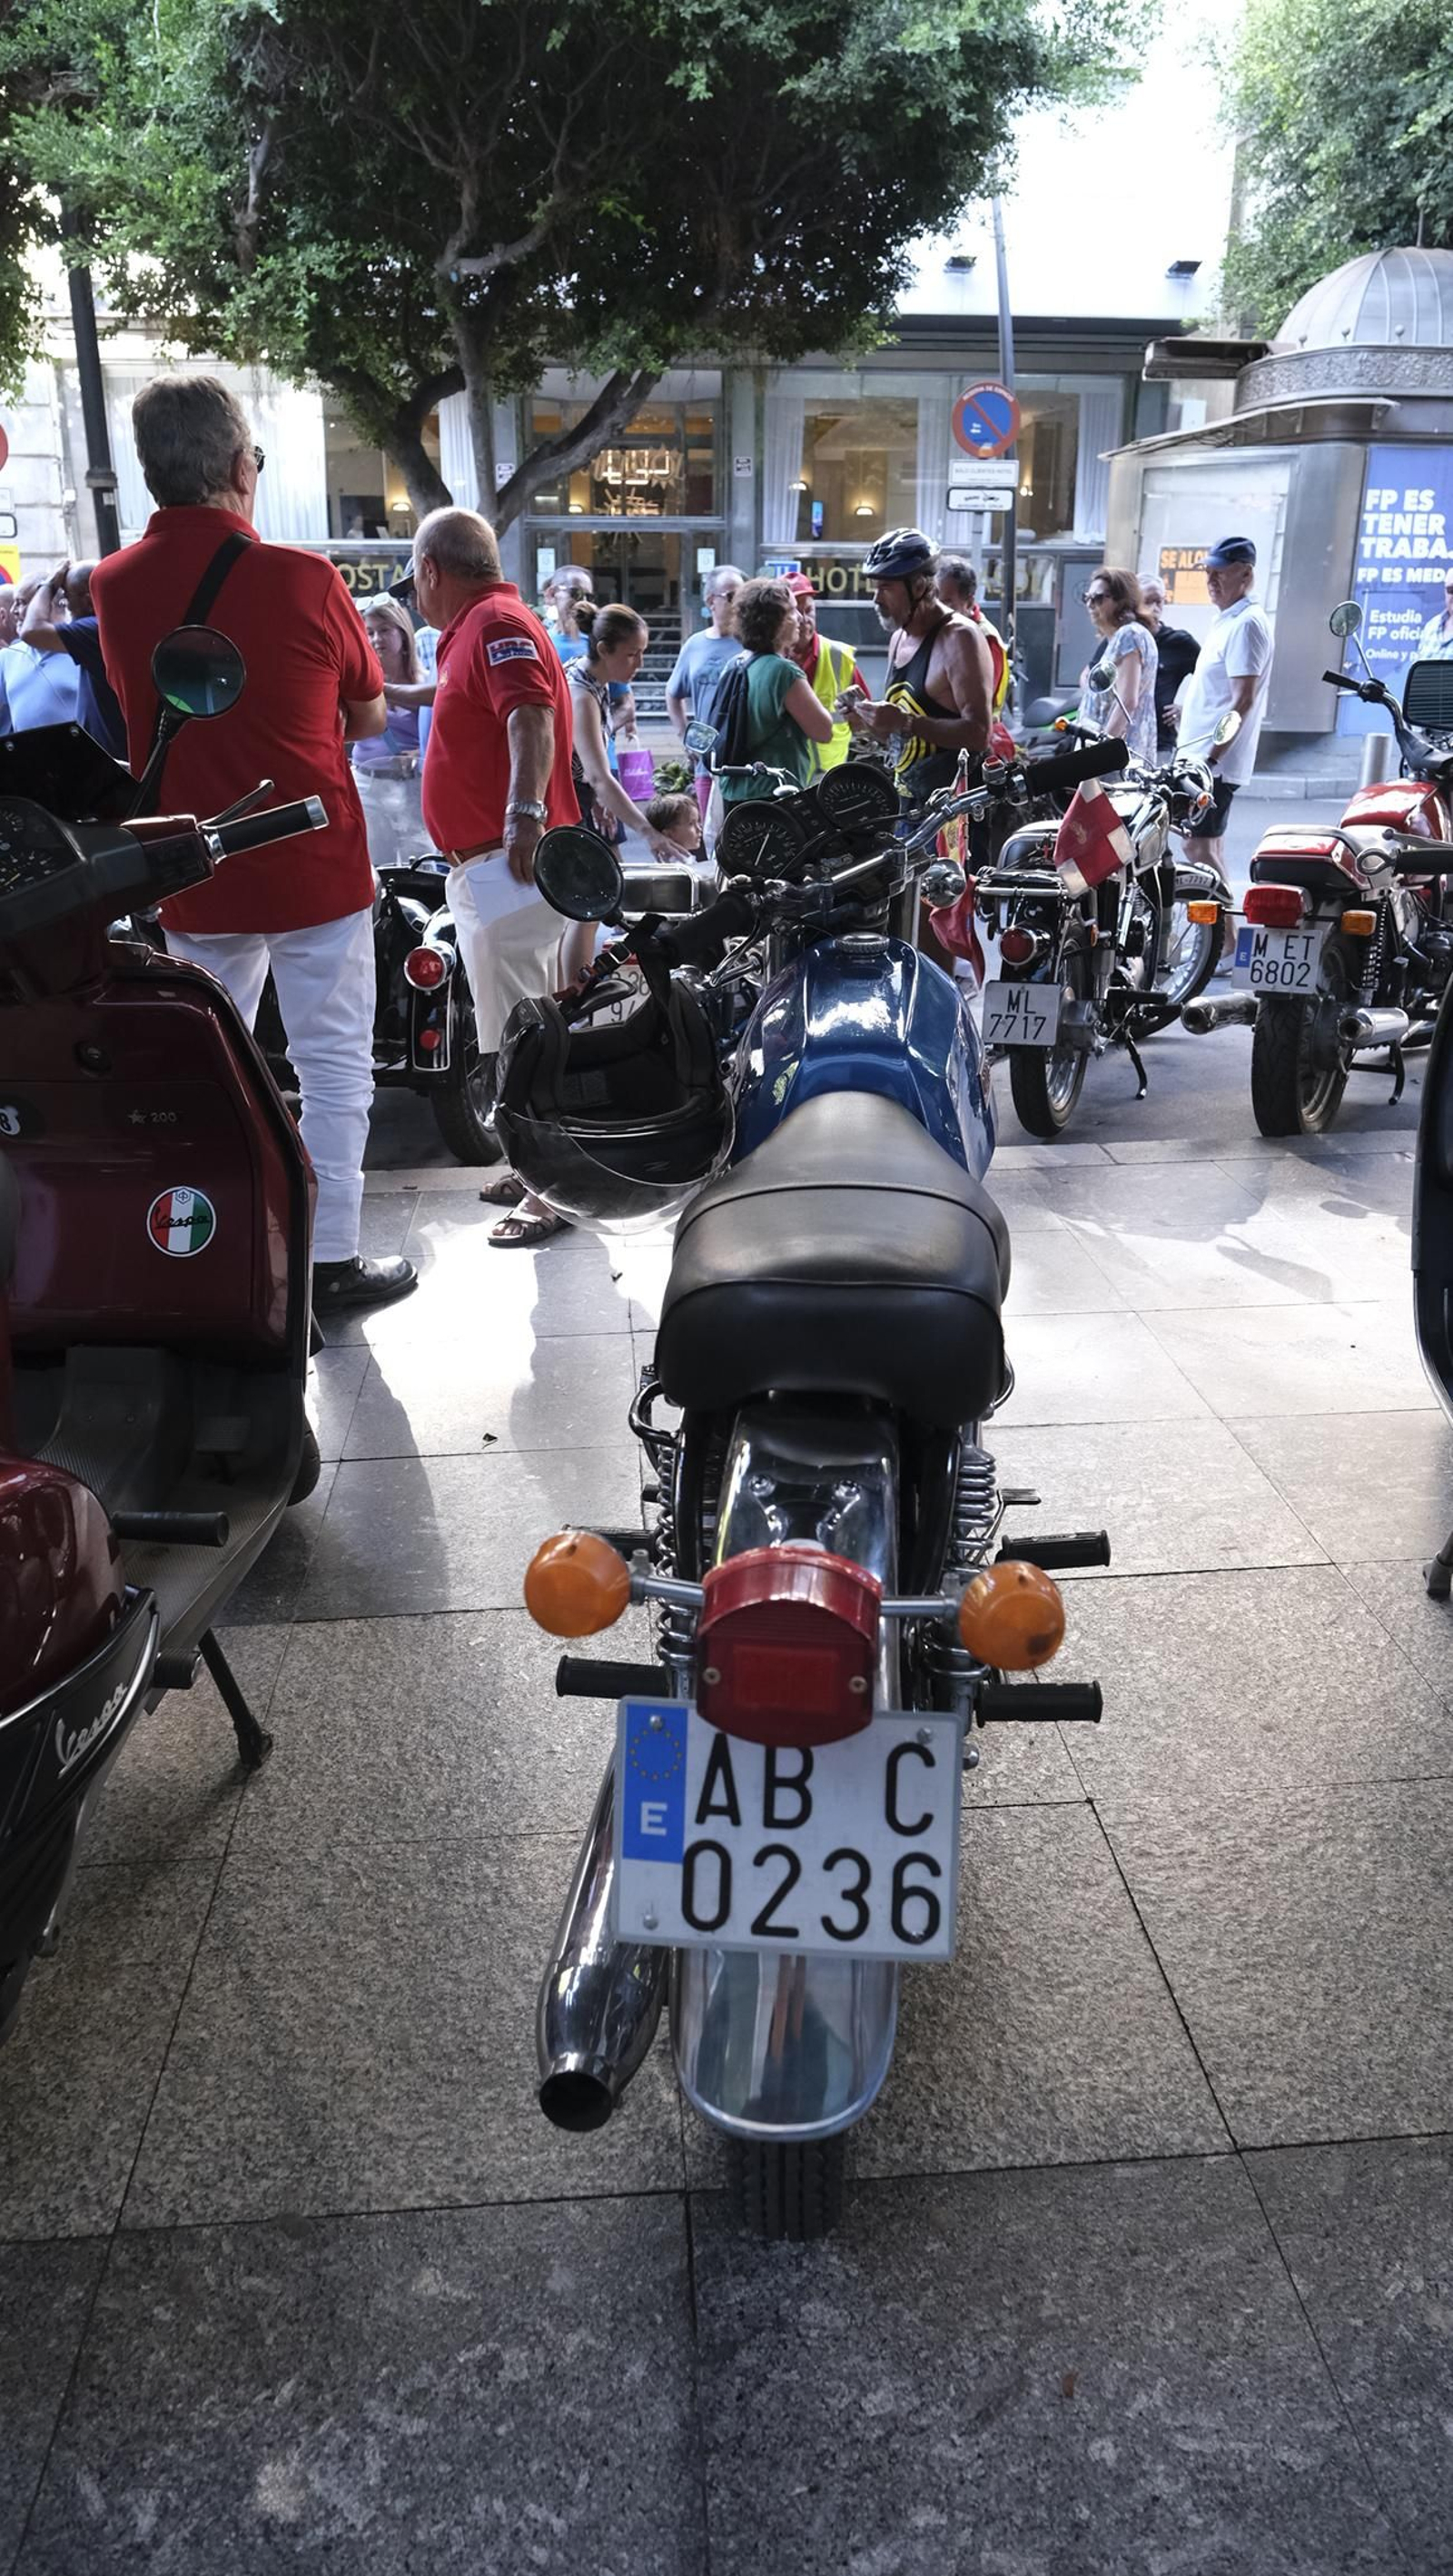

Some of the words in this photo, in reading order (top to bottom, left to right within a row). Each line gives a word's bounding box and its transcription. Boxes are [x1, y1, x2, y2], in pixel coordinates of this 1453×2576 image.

[1365, 489, 1399, 511] FP
[1403, 489, 1436, 511] ES
[1363, 512, 1446, 536] TENER
[336, 562, 405, 590] OSTA
[1357, 567, 1379, 583] FP
[1381, 567, 1403, 583] ES
[1406, 567, 1448, 583] MED
[1369, 608, 1422, 624] Estudia
[1368, 626, 1388, 639] FP
[1389, 625, 1423, 640] ofici
[1366, 647, 1399, 659] Online
[1240, 952, 1248, 961] E
[1253, 933, 1269, 957] M
[1284, 934, 1315, 961] ET
[1250, 959, 1311, 987] 6802
[1006, 989, 1036, 1013] ML
[988, 1013, 1047, 1041] 7717
[151, 1111, 178, 1122] 200
[153, 1205, 211, 1229] Vespa
[56, 1682, 129, 1780] Vespa
[640, 1801, 668, 1836] E
[681, 1839, 942, 1945] 0236
